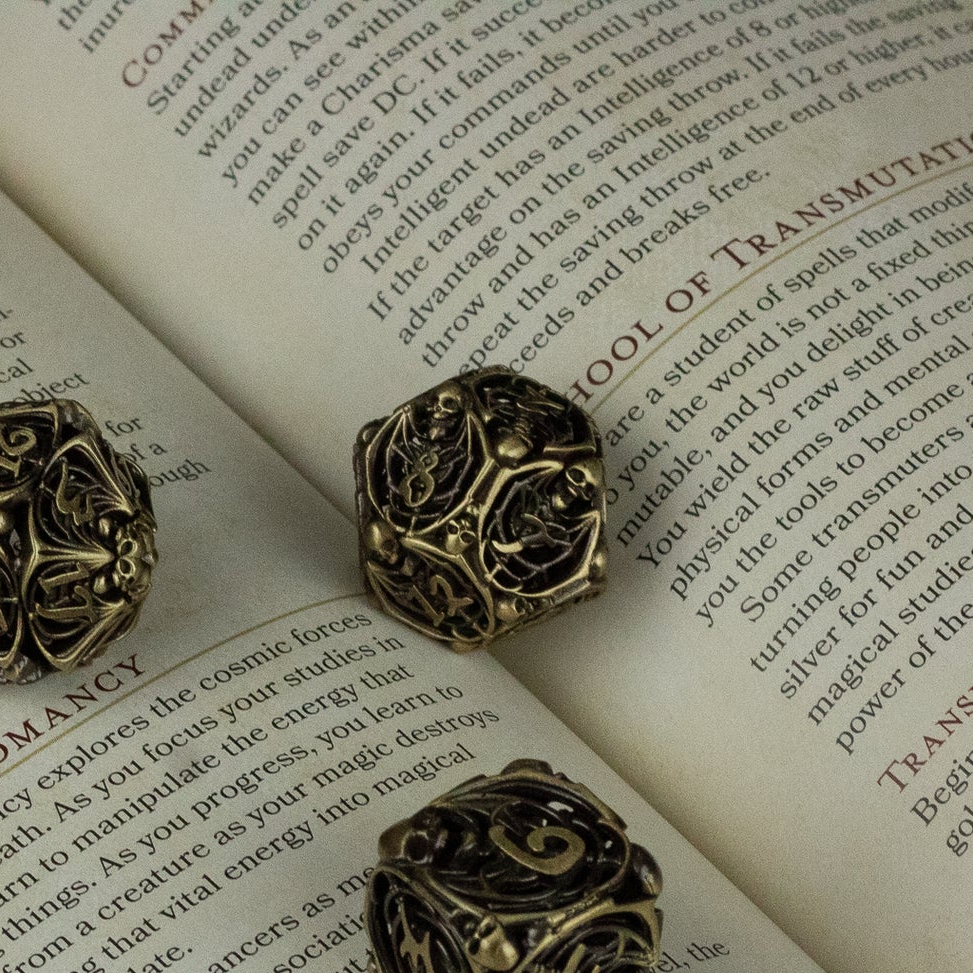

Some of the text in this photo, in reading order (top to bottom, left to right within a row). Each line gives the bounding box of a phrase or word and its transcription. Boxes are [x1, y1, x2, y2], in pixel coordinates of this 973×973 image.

[368, 27, 751, 321] If the target has an Intelligence of
[665, 270, 710, 313] OF
[670, 334, 971, 601] physical forms and mental
[750, 465, 973, 672] turning people into
[37, 715, 150, 790] explores
[149, 688, 197, 718] the
[199, 641, 293, 691] cosmic
[290, 615, 372, 647] forces
[54, 793, 92, 823] As
[91, 760, 144, 801] you
[142, 716, 219, 763] focus
[218, 681, 279, 724] your
[283, 636, 377, 687] studies
[376, 633, 406, 655] in
[101, 918, 160, 960] that
[159, 874, 222, 920] vital
[223, 820, 314, 880] energy
[316, 792, 370, 826] into
[372, 742, 476, 796] magical
